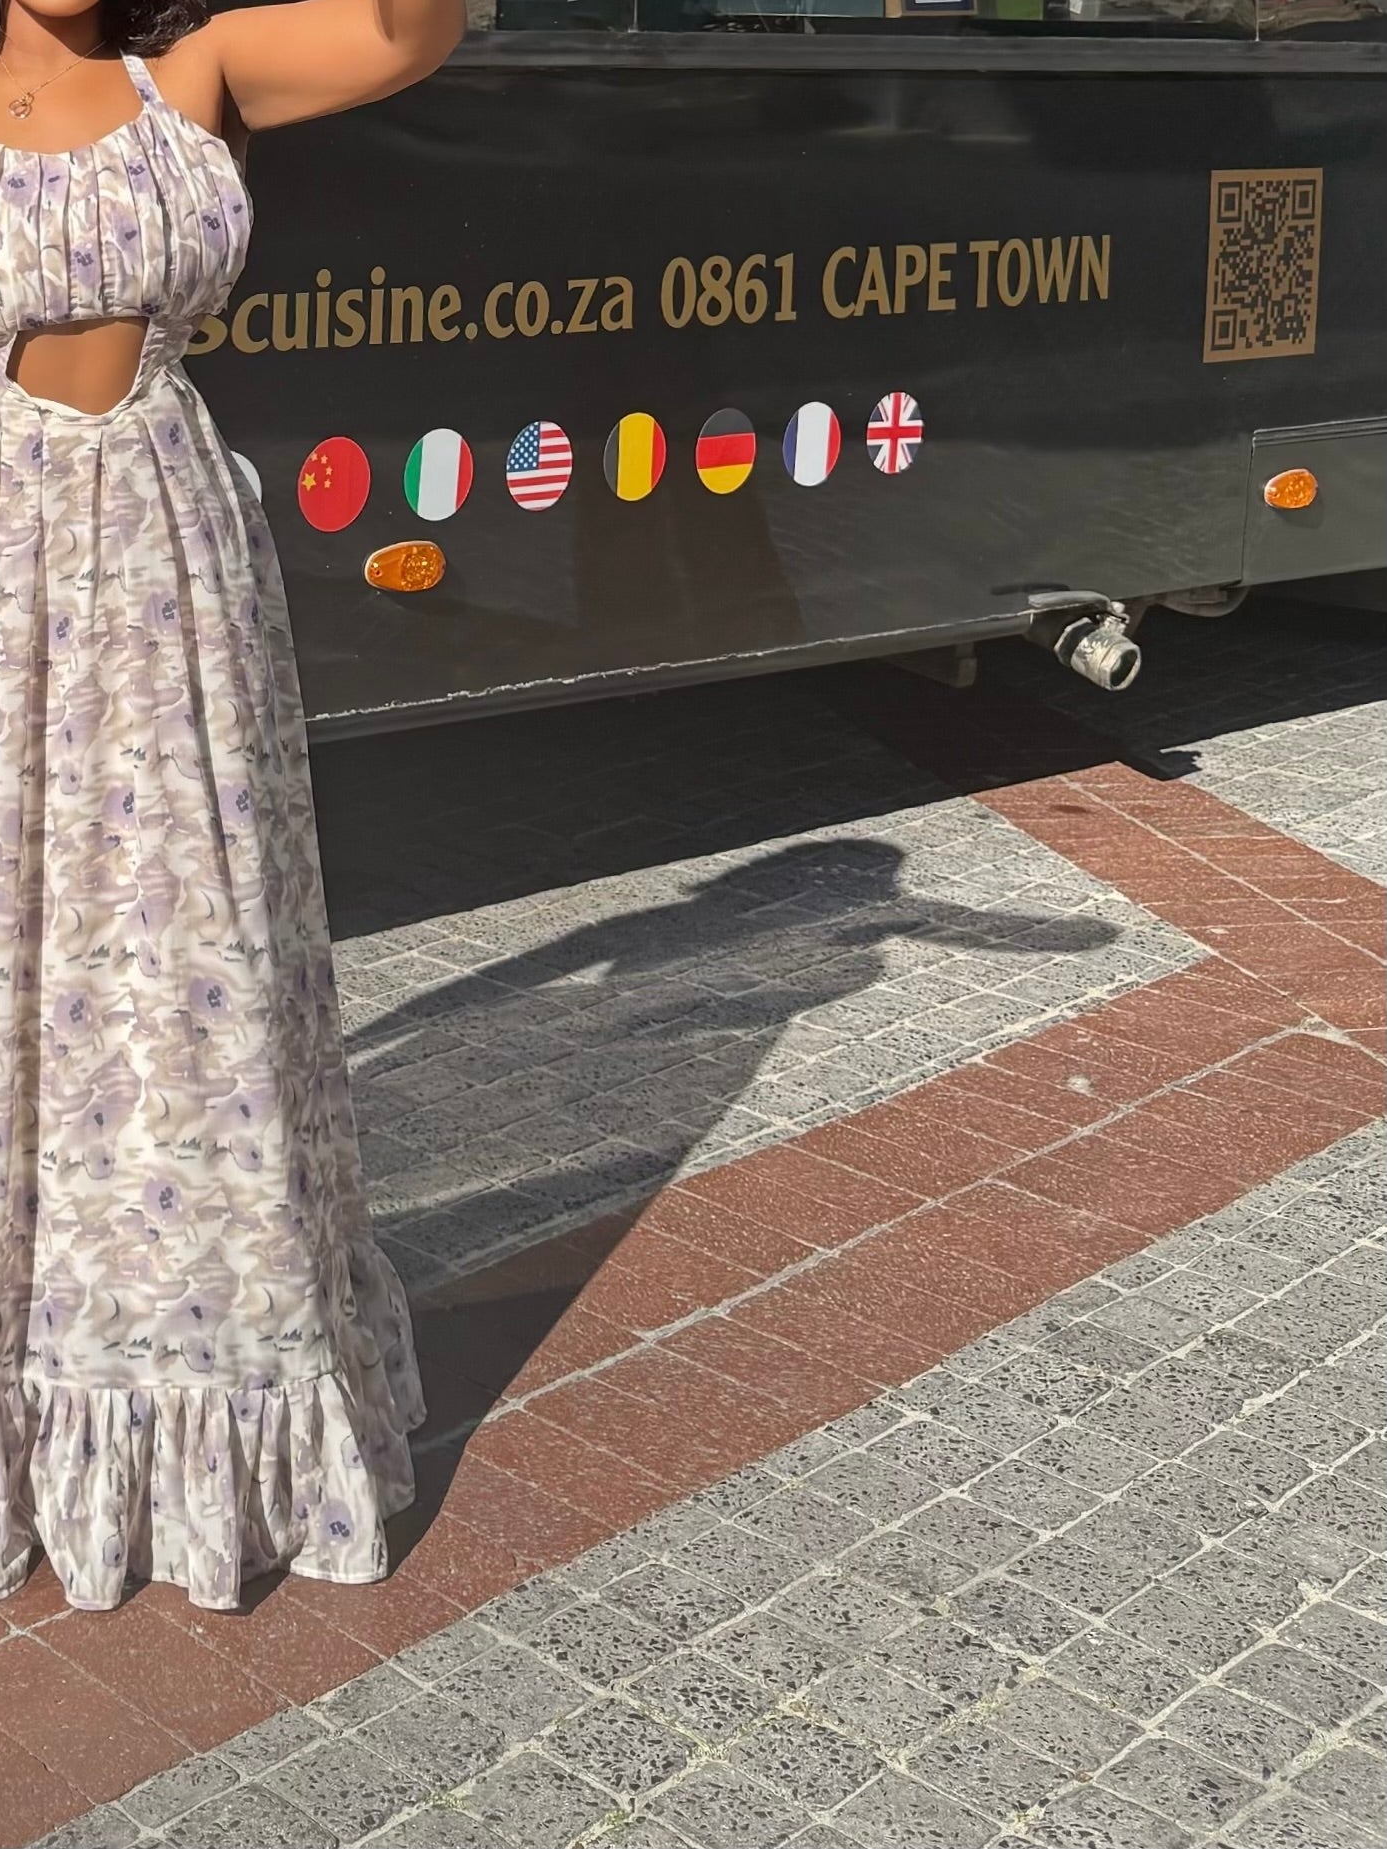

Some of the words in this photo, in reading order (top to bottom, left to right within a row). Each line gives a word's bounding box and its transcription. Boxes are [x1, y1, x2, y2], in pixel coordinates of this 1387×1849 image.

[660, 254, 796, 329] 0861
[822, 239, 957, 320] CAPE
[969, 235, 1112, 309] TOWN
